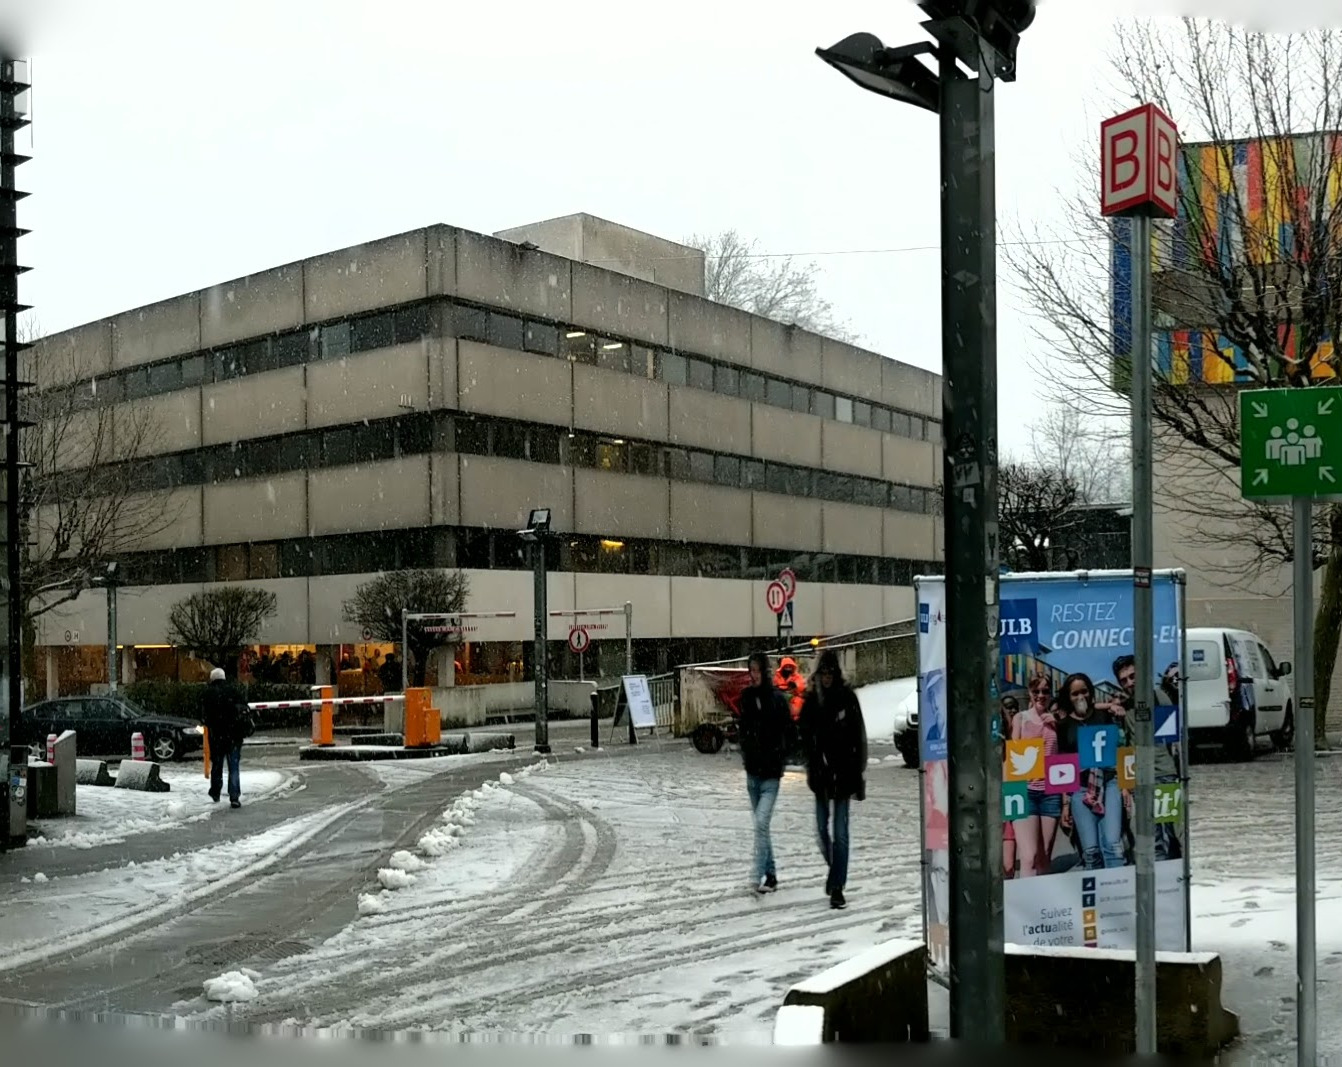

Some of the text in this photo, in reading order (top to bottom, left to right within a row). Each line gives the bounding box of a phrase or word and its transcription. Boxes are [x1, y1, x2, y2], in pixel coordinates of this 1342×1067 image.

[1111, 130, 1140, 193] B
[1158, 128, 1172, 191] B
[1051, 602, 1117, 623] RESTEZ
[1040, 907, 1072, 920] Suivez
[1022, 920, 1073, 937] l'actualité
